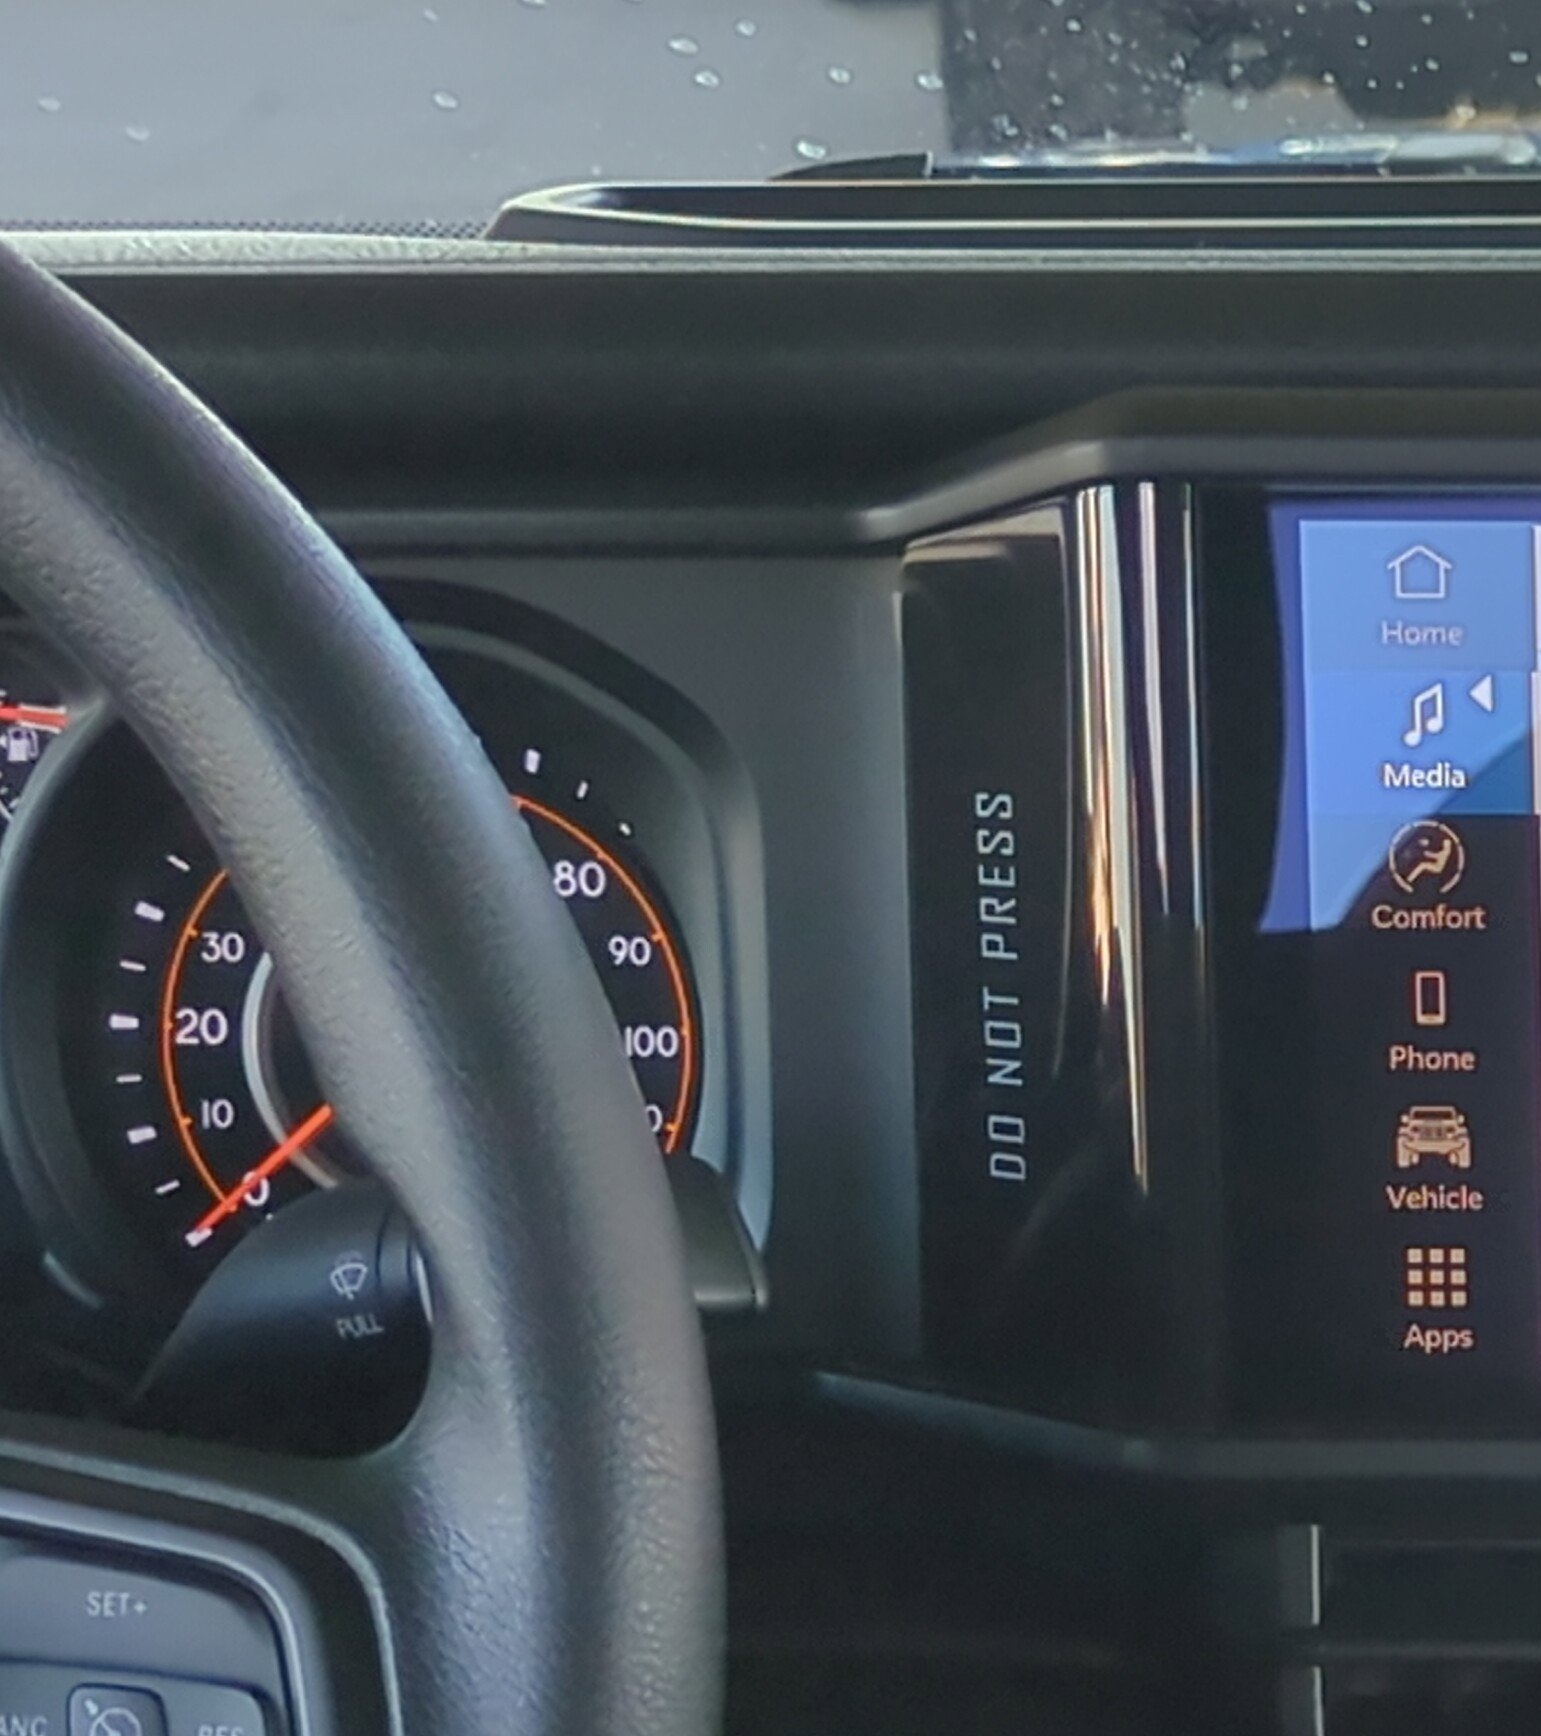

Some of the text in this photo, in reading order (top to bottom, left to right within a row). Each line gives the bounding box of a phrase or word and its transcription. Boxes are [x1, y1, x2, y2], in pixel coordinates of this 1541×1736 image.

[1380, 619, 1464, 646] Home
[1382, 762, 1467, 789] Media
[553, 860, 607, 899] 80
[1370, 904, 1487, 931] Comfort
[200, 931, 245, 963] 30
[607, 935, 652, 968] 90
[974, 791, 1027, 1182] DO NOT PRESS
[174, 1008, 228, 1046] 20
[625, 1025, 679, 1059] 100
[1388, 1045, 1476, 1072] Phone
[201, 1101, 234, 1129] 10
[1385, 1184, 1484, 1212] Vehicle
[1402, 1324, 1475, 1353] Apps
